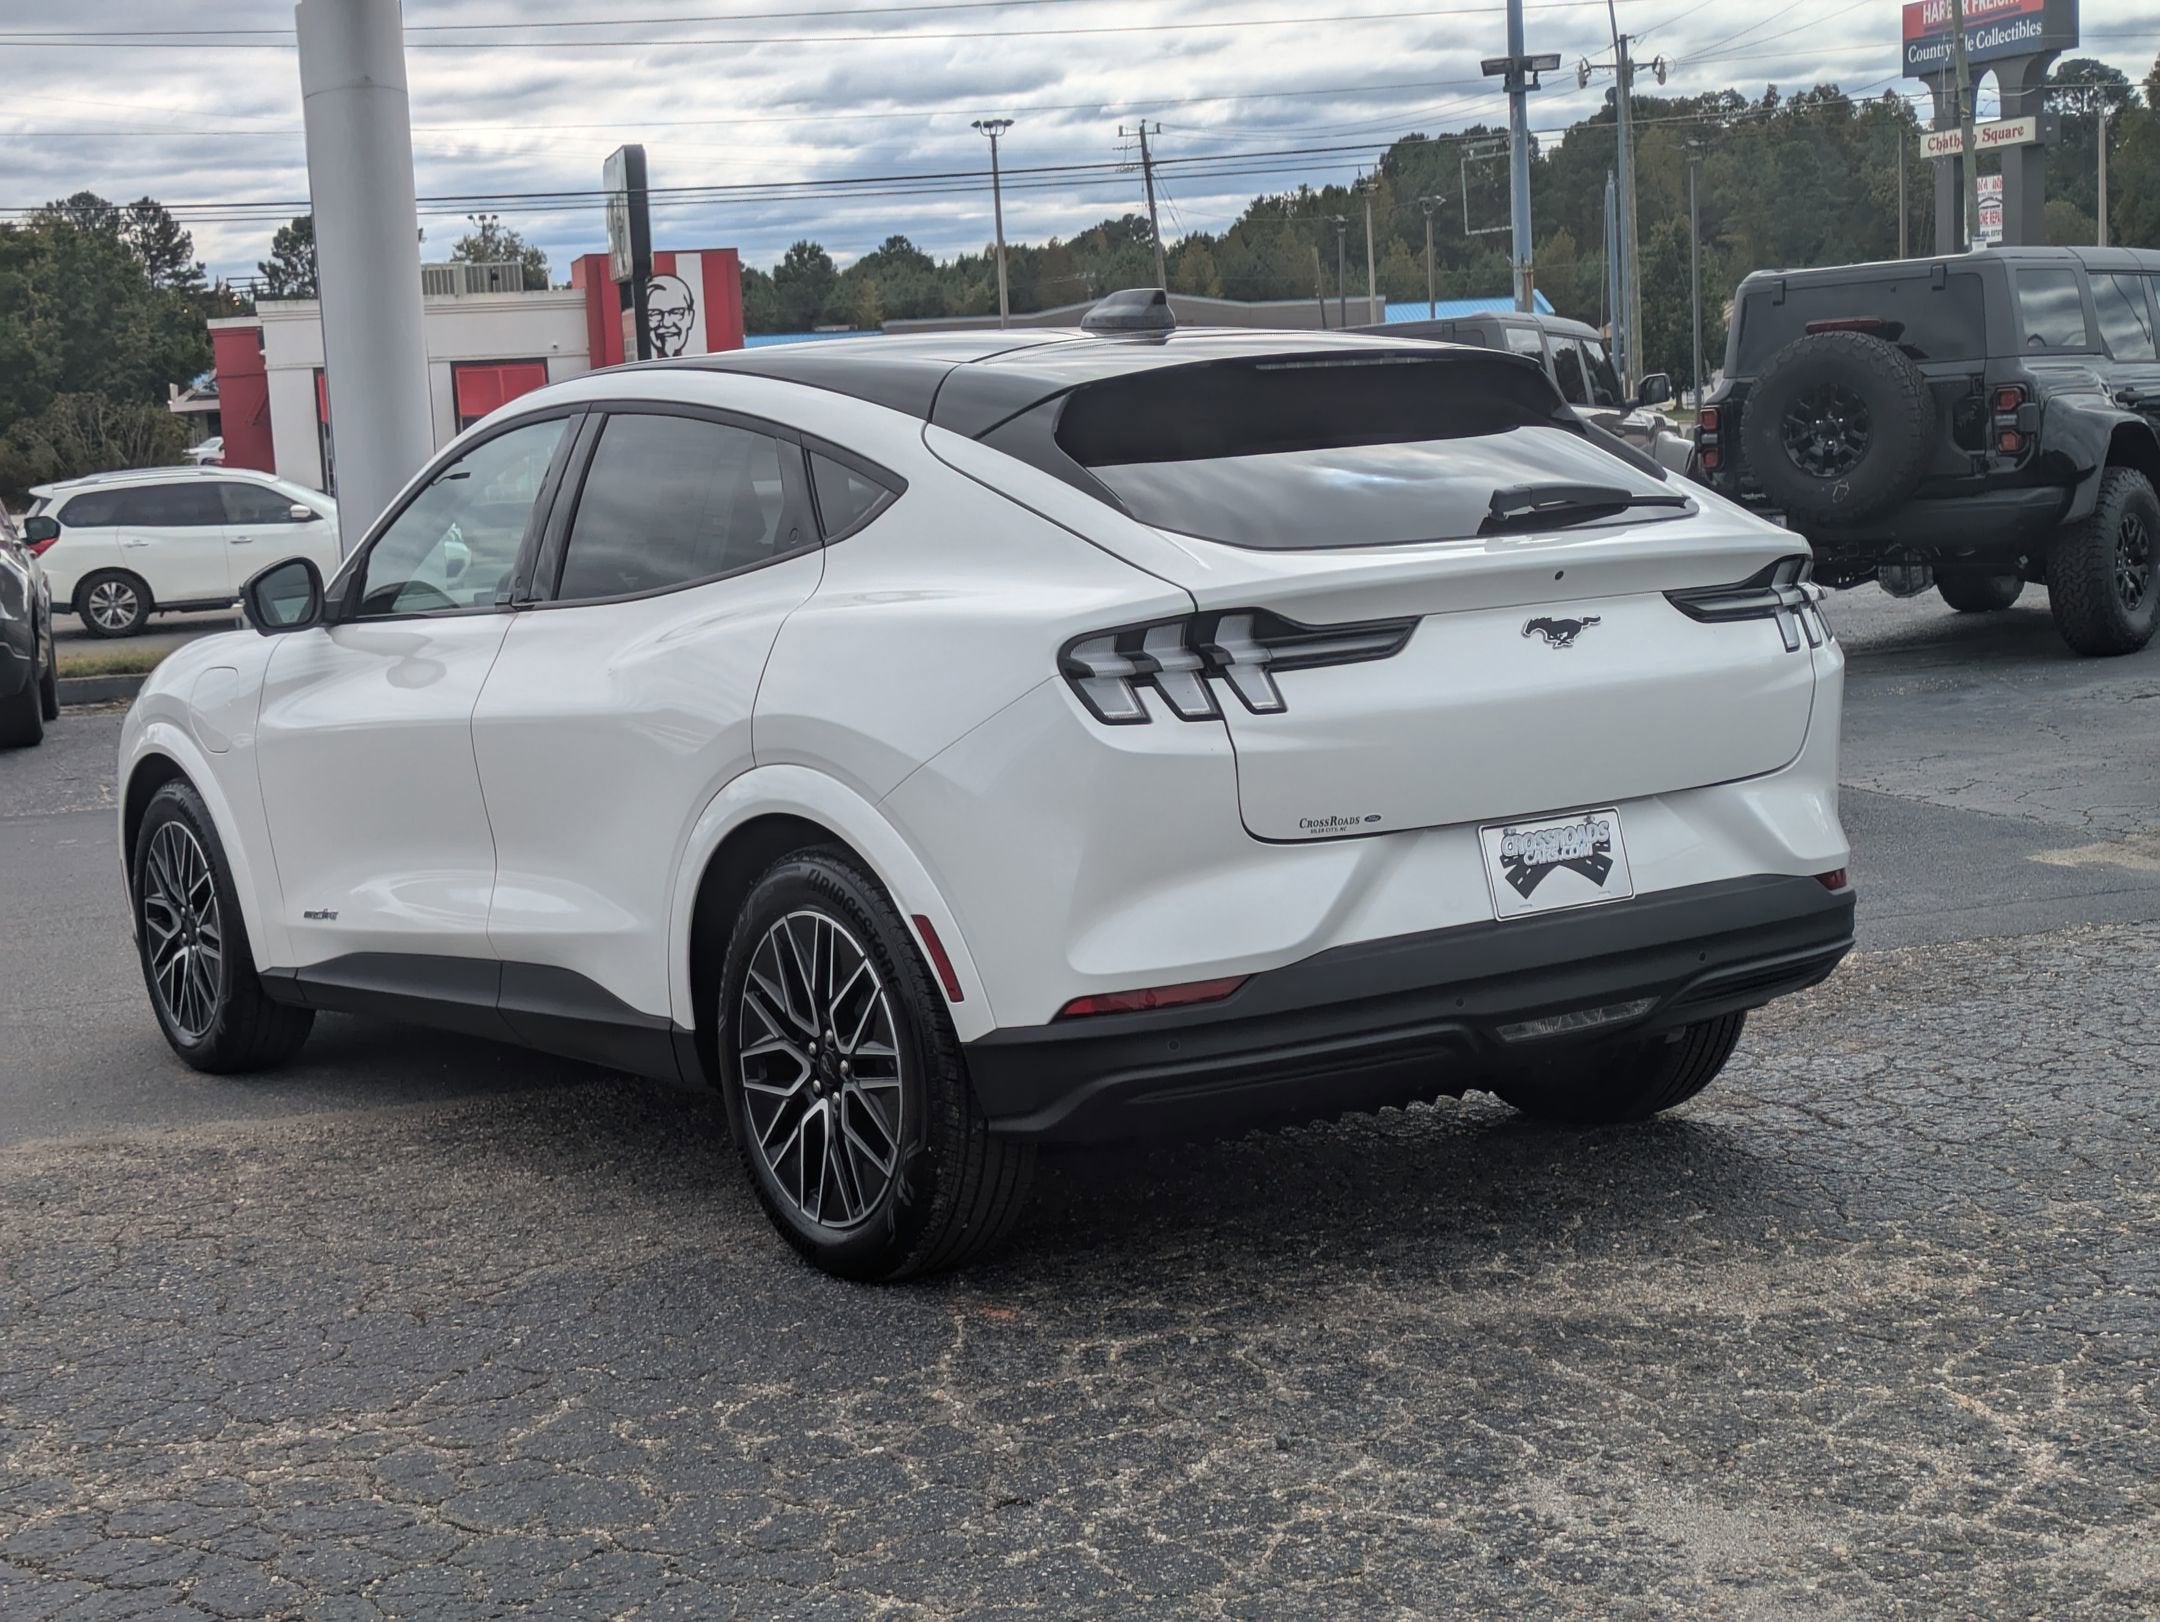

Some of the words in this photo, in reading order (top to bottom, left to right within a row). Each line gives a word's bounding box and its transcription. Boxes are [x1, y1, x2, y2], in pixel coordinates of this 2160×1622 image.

[1923, 0, 1969, 25] HARBR
[1976, 19, 2042, 50] Collectibles
[1982, 125, 2024, 145] Square
[1501, 820, 1610, 857] CROSSROADS
